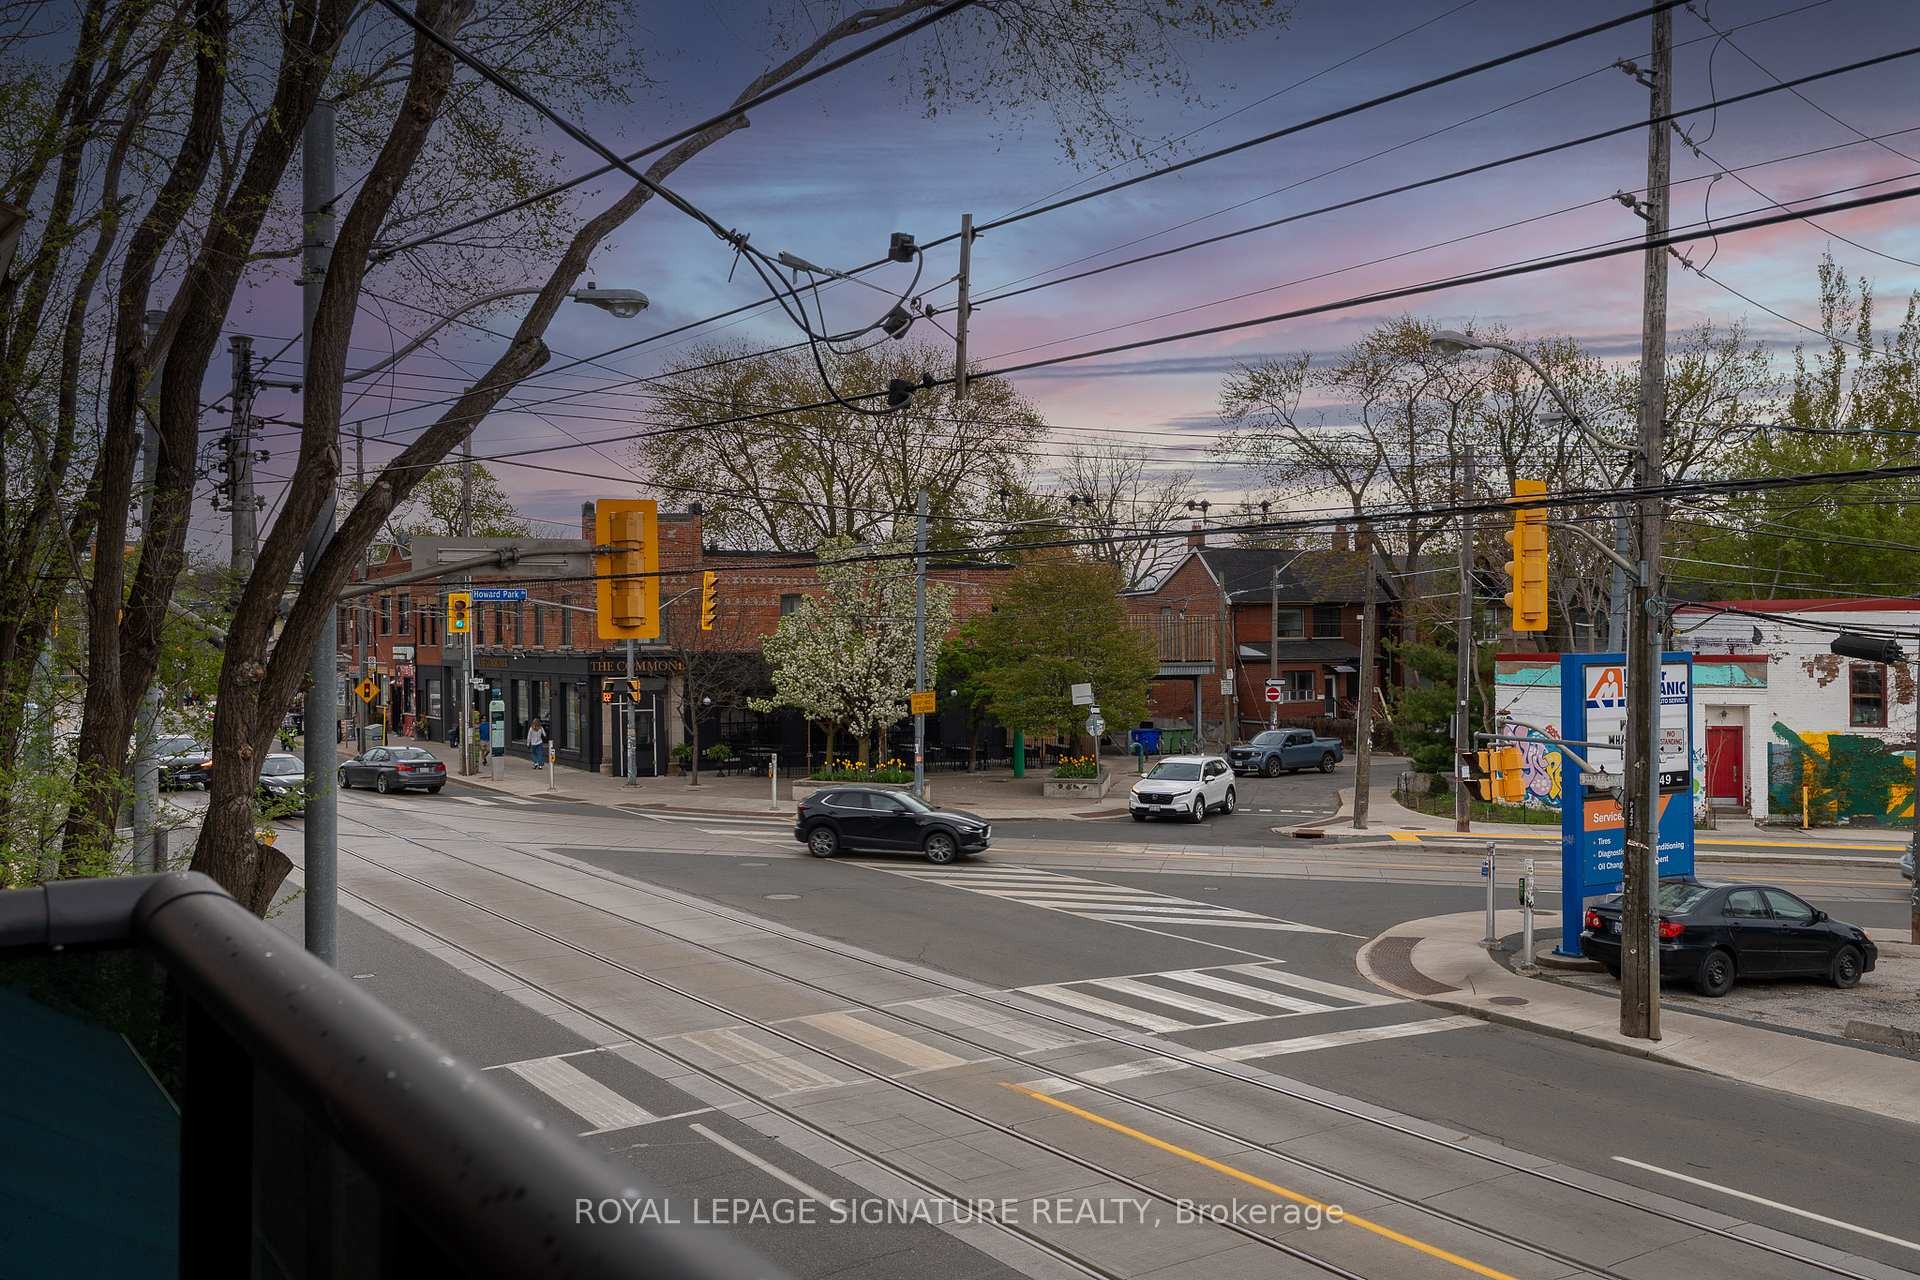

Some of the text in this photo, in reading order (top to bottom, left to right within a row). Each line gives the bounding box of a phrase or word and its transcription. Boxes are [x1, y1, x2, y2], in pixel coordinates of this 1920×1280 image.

[473, 590, 502, 599] Howard
[503, 590, 520, 599] Park
[591, 661, 685, 672] THE CMMONS
[1660, 681, 1686, 695] ANIC
[1666, 730, 1676, 738] NO
[1655, 841, 1685, 853] nditioning
[1606, 861, 1624, 871] Chang
